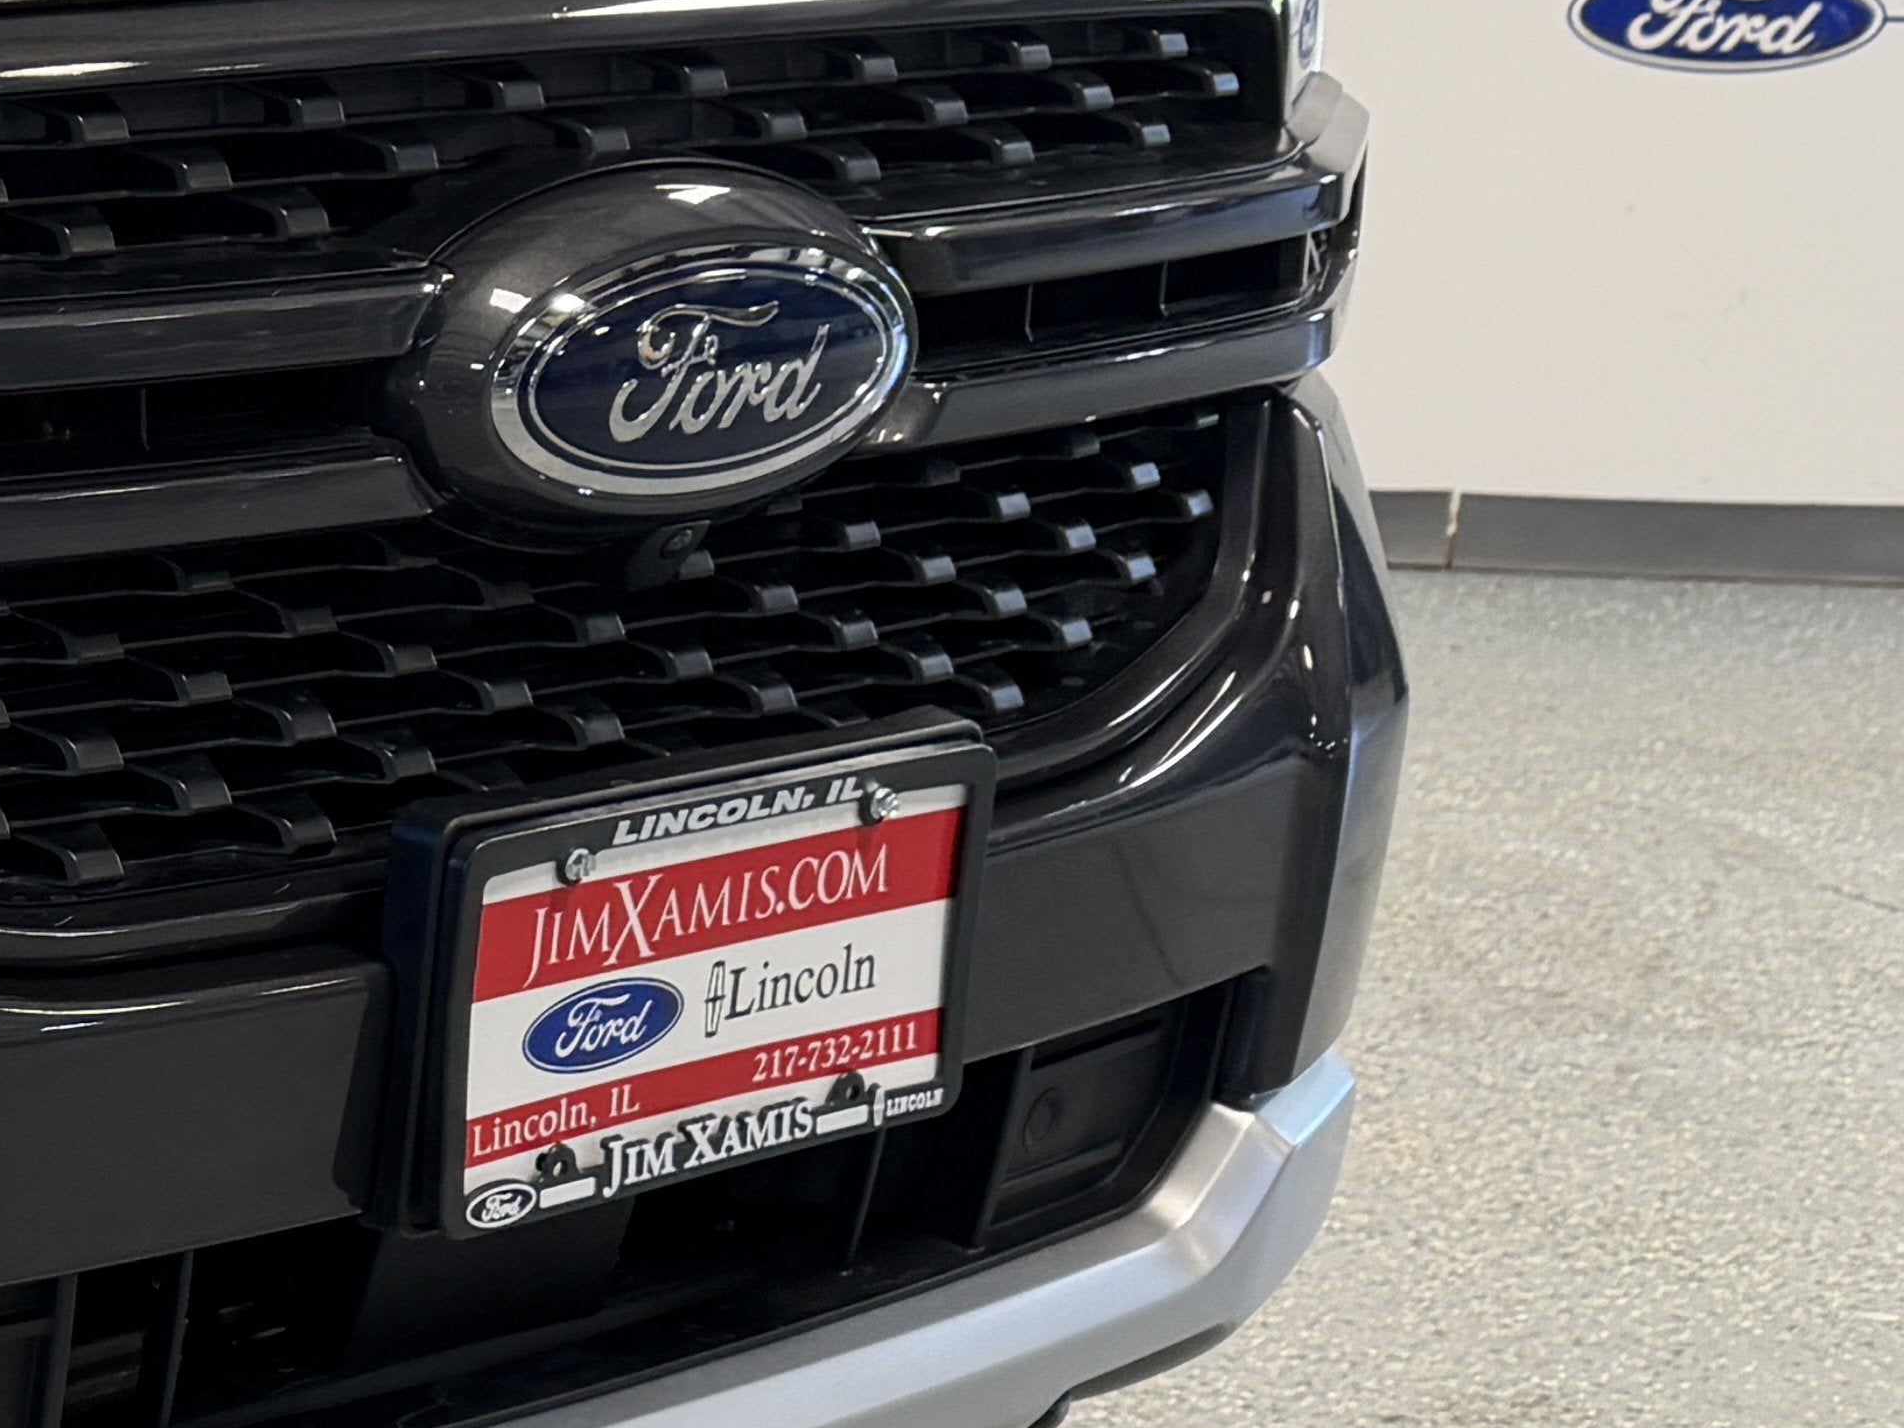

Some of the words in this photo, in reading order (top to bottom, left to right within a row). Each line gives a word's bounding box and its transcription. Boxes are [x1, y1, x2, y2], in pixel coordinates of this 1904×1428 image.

[608, 299, 832, 443] Ford
[612, 785, 815, 847] LINCOLN,
[825, 776, 865, 805] IL
[523, 843, 888, 989] JIMXAMIS.COM
[724, 943, 877, 1021] Lincoln
[554, 992, 653, 1059] Ford
[752, 1021, 918, 1083] 217-732-2111
[472, 1096, 597, 1158] Lincoln,
[608, 1084, 640, 1117] IL
[602, 1136, 677, 1198] JIM
[683, 1100, 814, 1170] XAMIS
[481, 1192, 522, 1223] Ford
